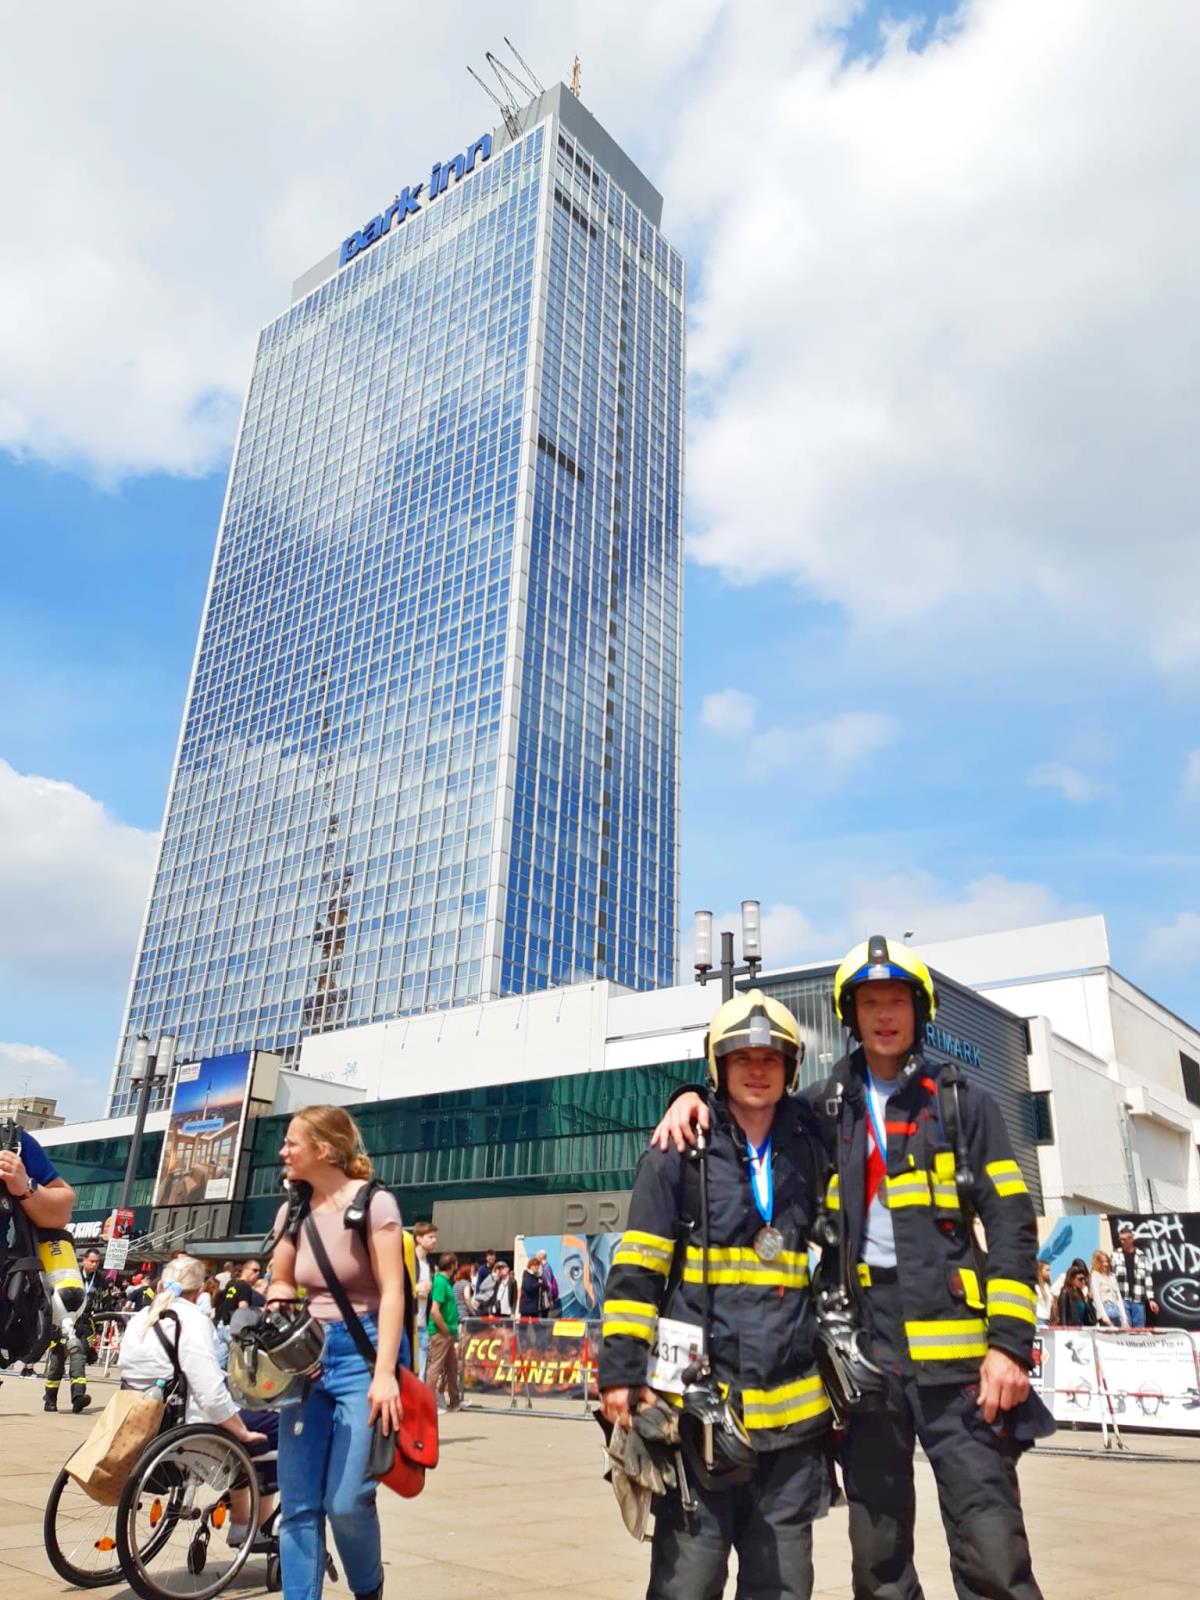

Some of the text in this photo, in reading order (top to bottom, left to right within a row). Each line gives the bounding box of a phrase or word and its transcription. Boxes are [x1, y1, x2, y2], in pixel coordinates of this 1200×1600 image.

[338, 133, 492, 268] park inn
[75, 1221, 102, 1239] KING
[465, 1339, 502, 1360] FCC
